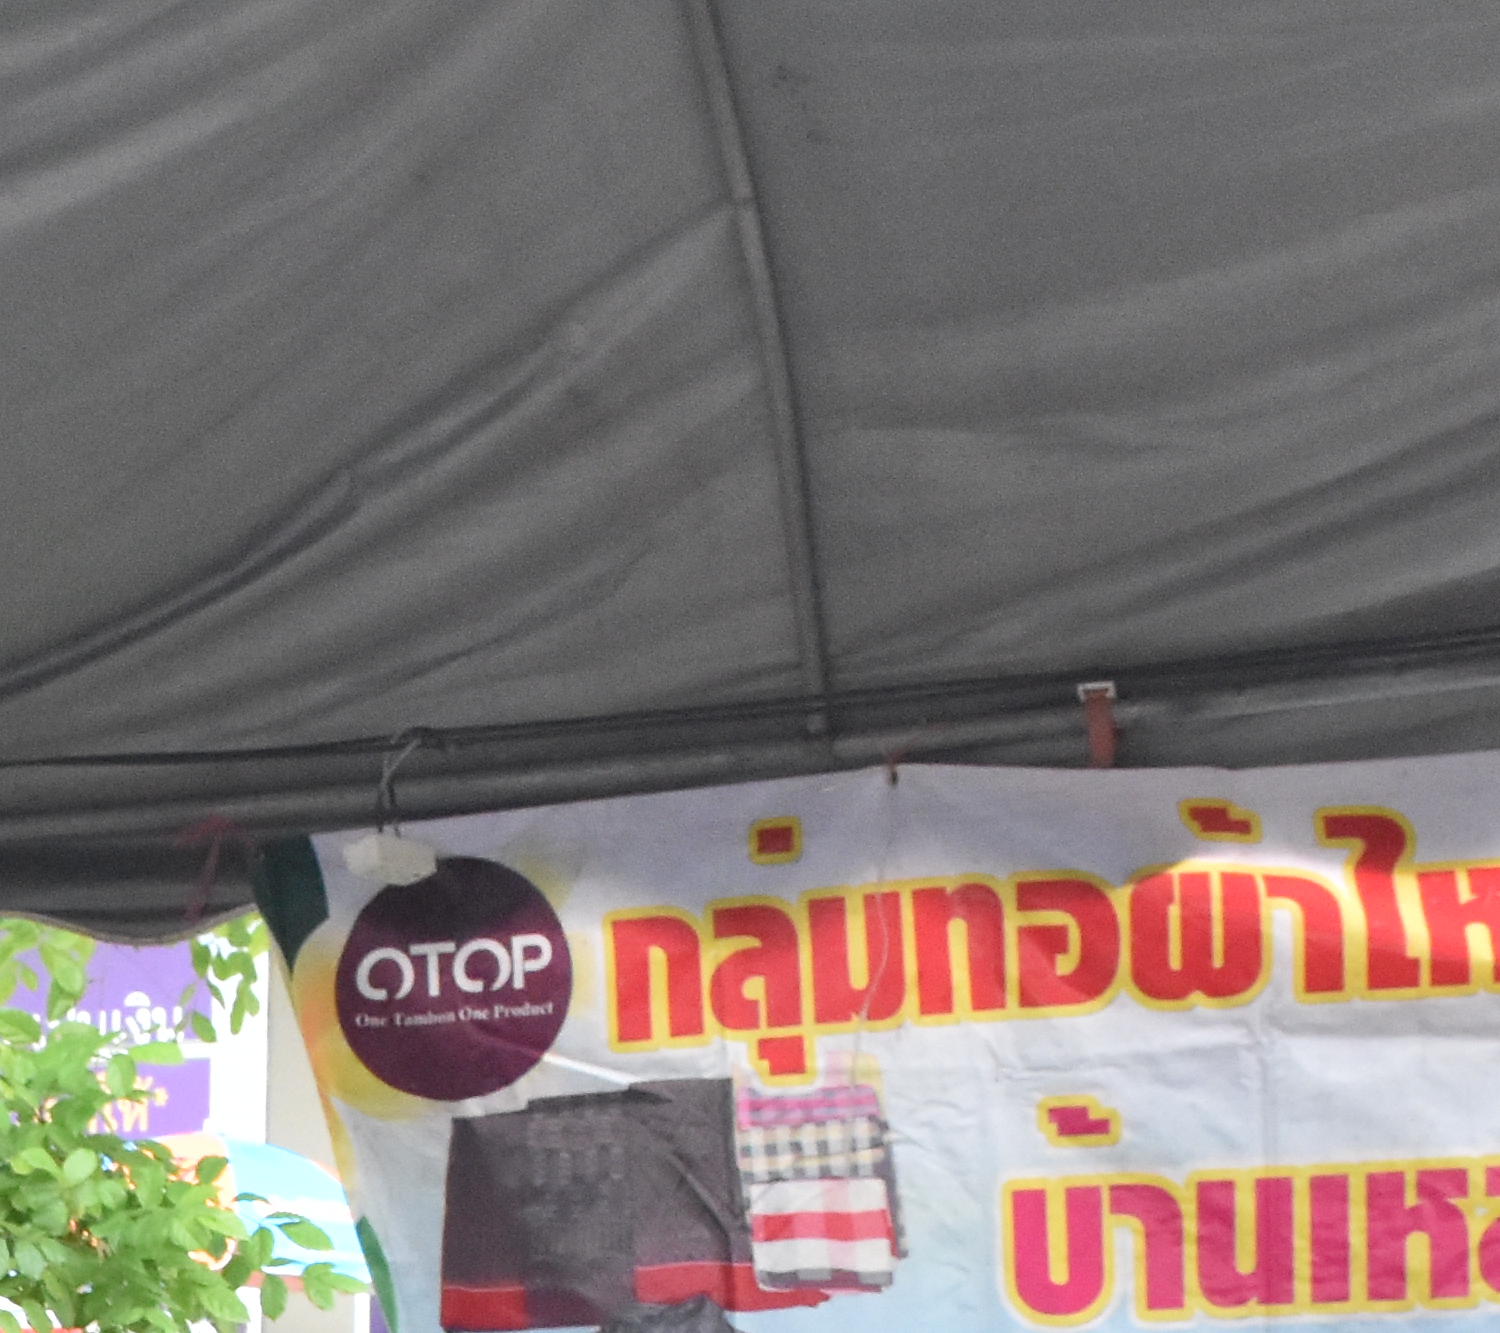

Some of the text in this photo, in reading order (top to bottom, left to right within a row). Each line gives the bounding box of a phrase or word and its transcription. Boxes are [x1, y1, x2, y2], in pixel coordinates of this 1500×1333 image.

[354, 932, 553, 1001] OTOP
[355, 1000, 553, 1028] One Tambon One Product
